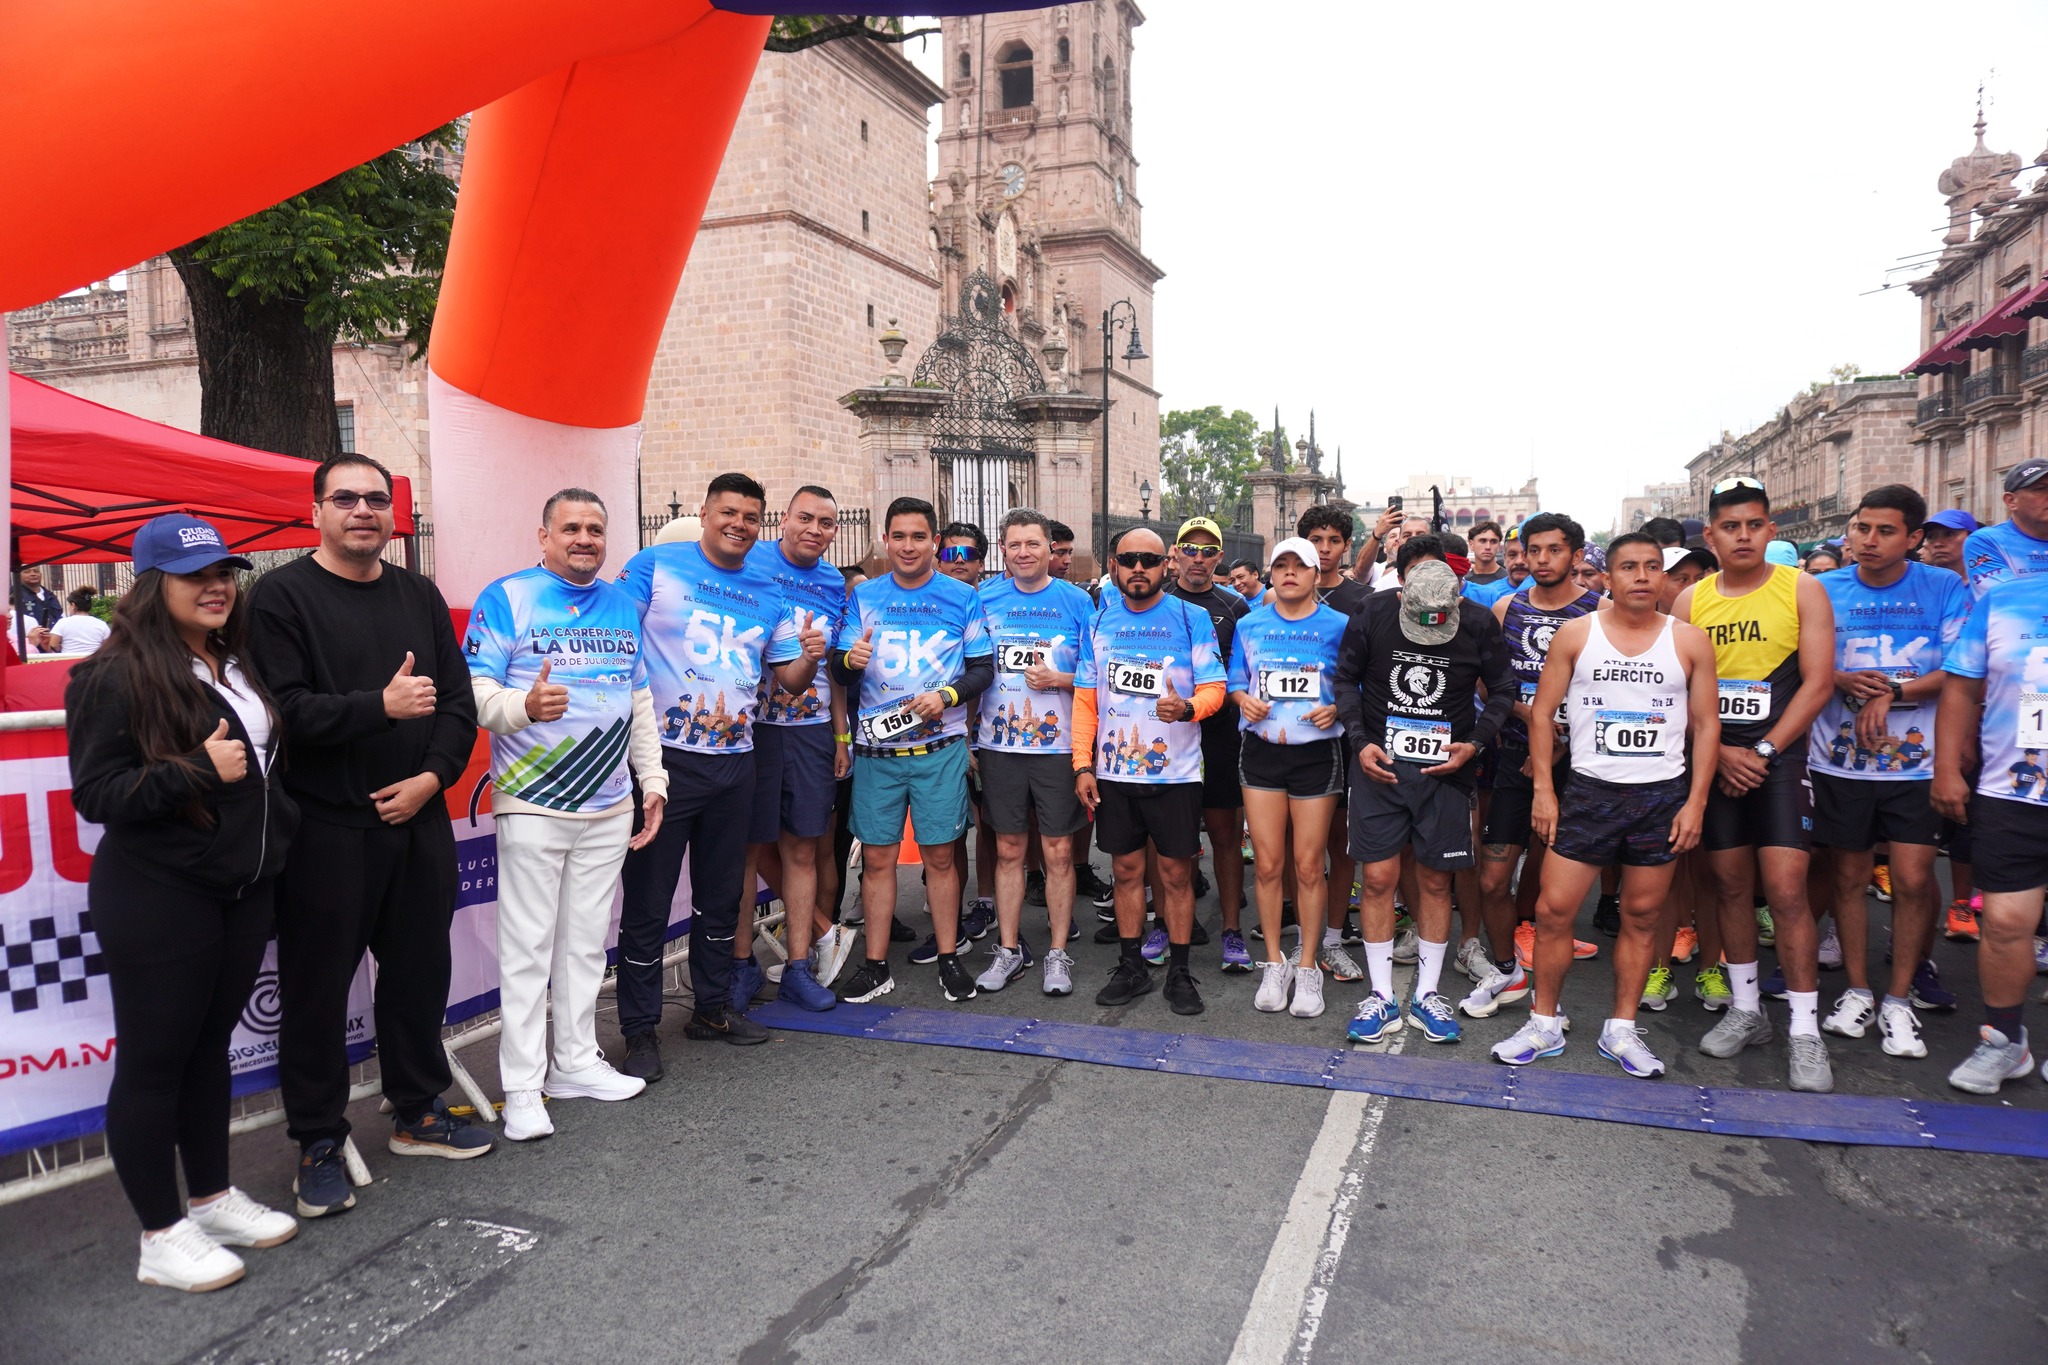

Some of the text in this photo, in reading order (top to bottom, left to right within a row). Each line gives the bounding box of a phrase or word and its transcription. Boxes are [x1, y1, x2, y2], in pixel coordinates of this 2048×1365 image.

[178, 526, 216, 536] CIUDAD
[697, 582, 720, 594] TRES
[772, 576, 794, 588] TRES
[694, 597, 722, 610] CAMINO
[724, 606, 746, 617] HACIA
[1849, 608, 1877, 616] TRES
[531, 628, 634, 640] LA CARRERA POR
[682, 608, 764, 674] 5K
[1706, 621, 1768, 646] TREYA.
[532, 638, 636, 655] LA UNIDAD
[875, 629, 948, 678] 5K
[554, 658, 566, 666] 20
[1122, 670, 1155, 689] 286
[1593, 669, 1664, 684] EJERCITO
[1279, 678, 1309, 693] 112
[1719, 697, 1760, 716] 065
[881, 711, 913, 733] 156
[1404, 736, 1442, 756] 367
[1618, 730, 1658, 748] 067
[240, 1055, 275, 1069] NECESITAS
